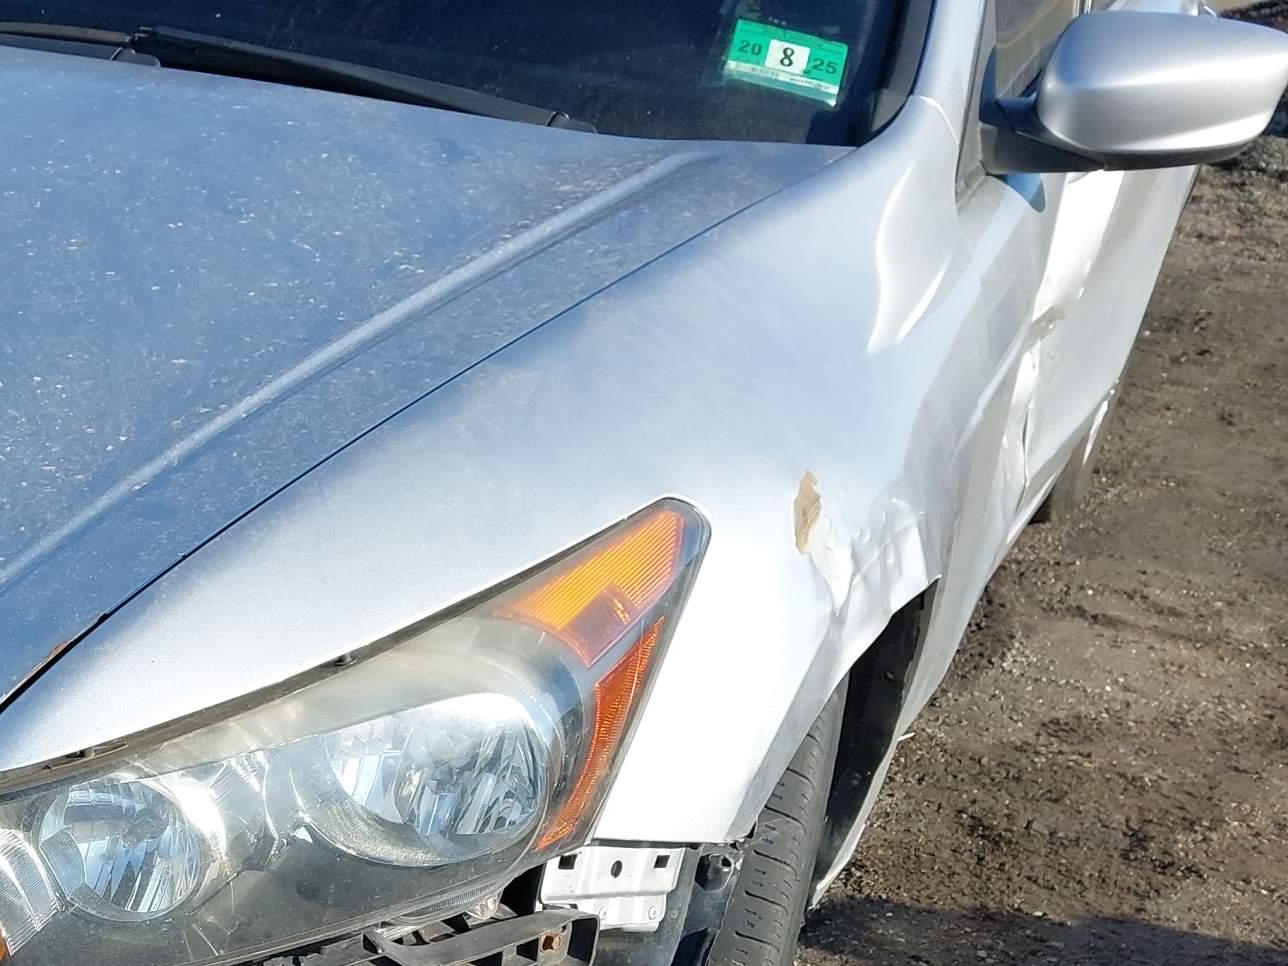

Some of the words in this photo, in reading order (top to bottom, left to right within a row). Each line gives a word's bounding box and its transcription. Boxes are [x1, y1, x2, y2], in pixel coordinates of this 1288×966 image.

[738, 40, 763, 56] 20
[780, 47, 795, 67] 8
[812, 58, 838, 75] 25
